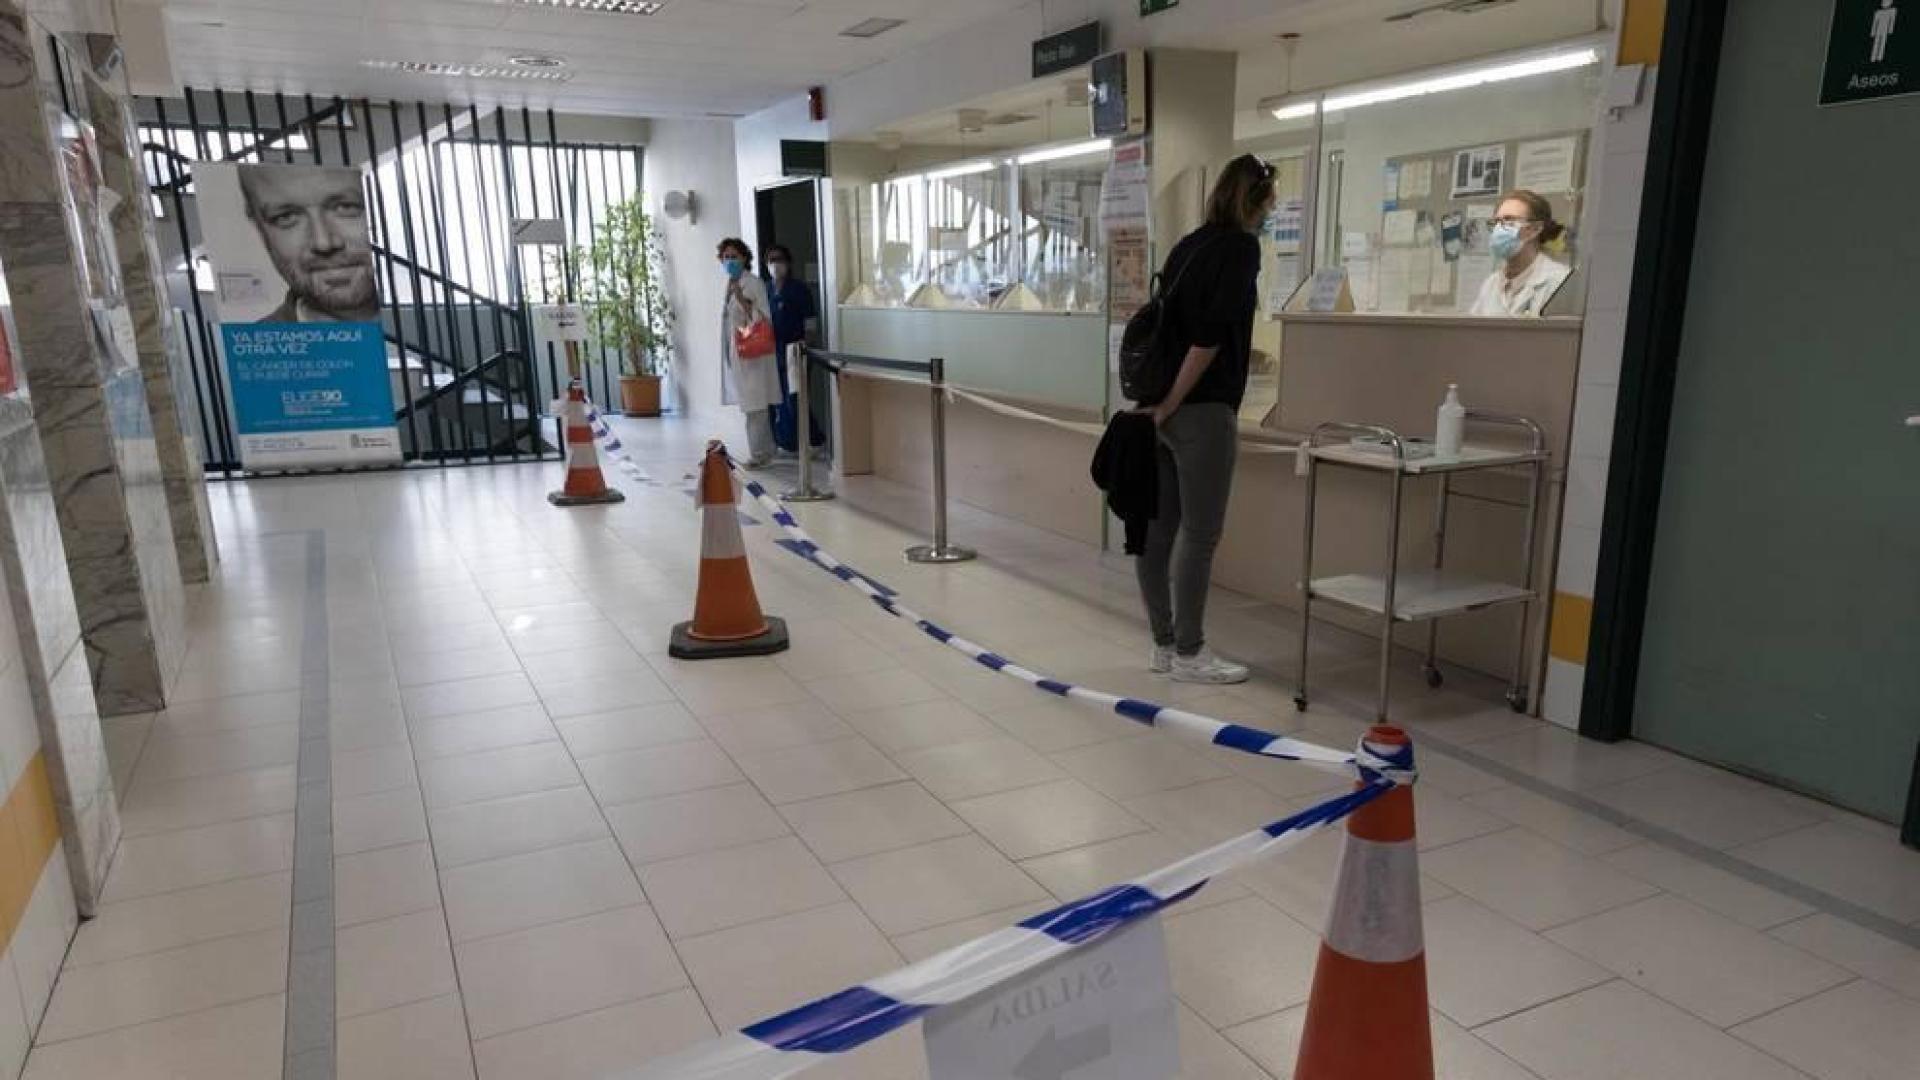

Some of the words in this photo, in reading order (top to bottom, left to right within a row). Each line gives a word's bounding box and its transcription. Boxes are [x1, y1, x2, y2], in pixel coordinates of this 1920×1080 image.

[1847, 72, 1899, 90] Aseos
[232, 331, 249, 344] YA
[254, 330, 324, 344] ESTAMOS
[233, 344, 276, 355] OTRA
[279, 343, 309, 354] VEZ
